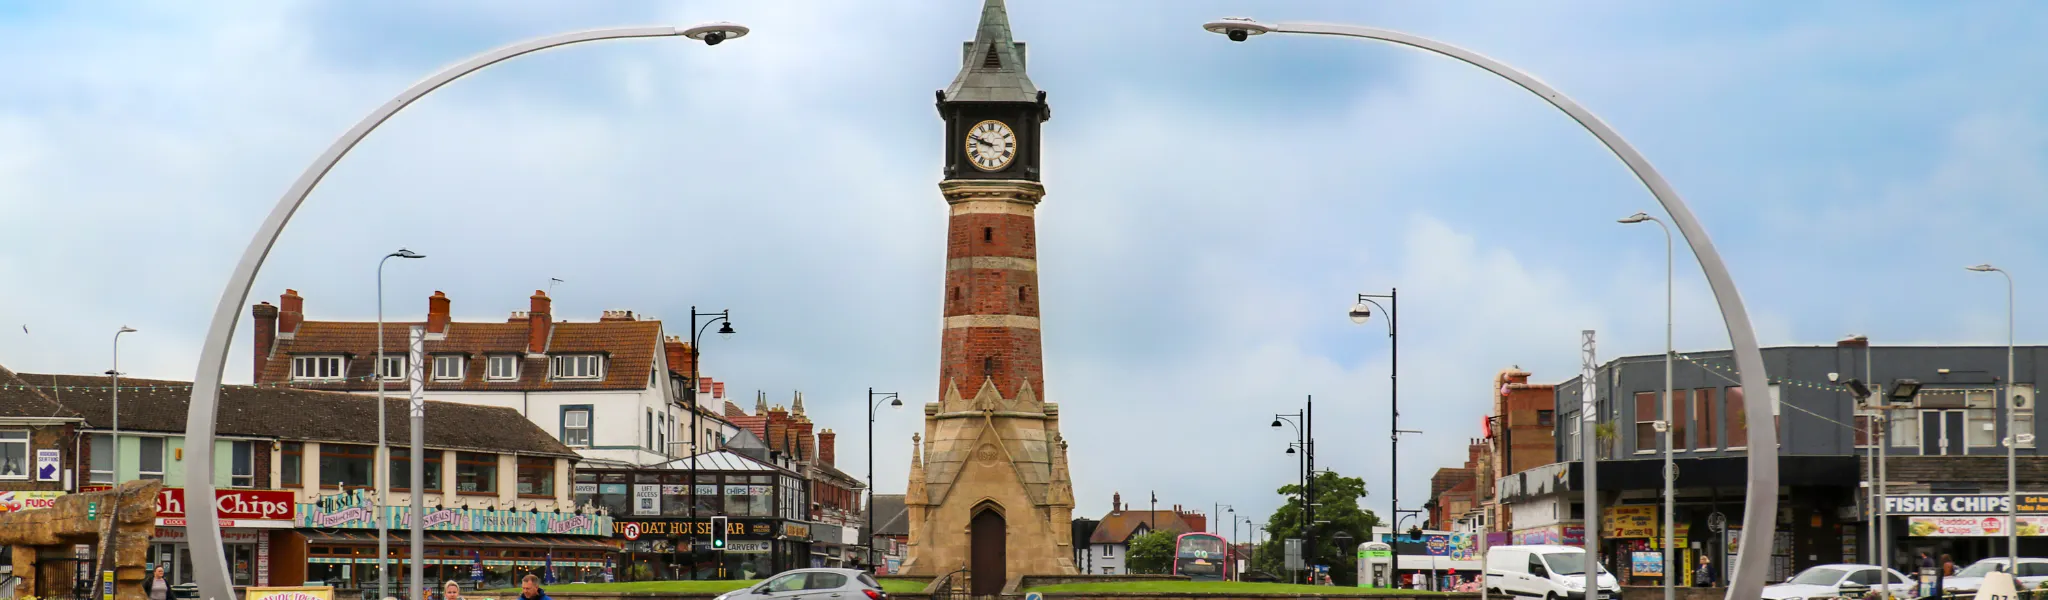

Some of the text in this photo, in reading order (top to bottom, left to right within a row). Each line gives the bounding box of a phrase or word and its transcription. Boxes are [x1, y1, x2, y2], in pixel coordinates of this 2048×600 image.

[726, 487, 747, 495] CHIPS
[216, 493, 288, 519] Chips
[1885, 496, 2010, 512] FISH & CHIPS
[482, 515, 498, 526] FISH
[637, 521, 667, 534] OAT
[726, 522, 745, 535] AR
[727, 543, 759, 551] CARVERY
